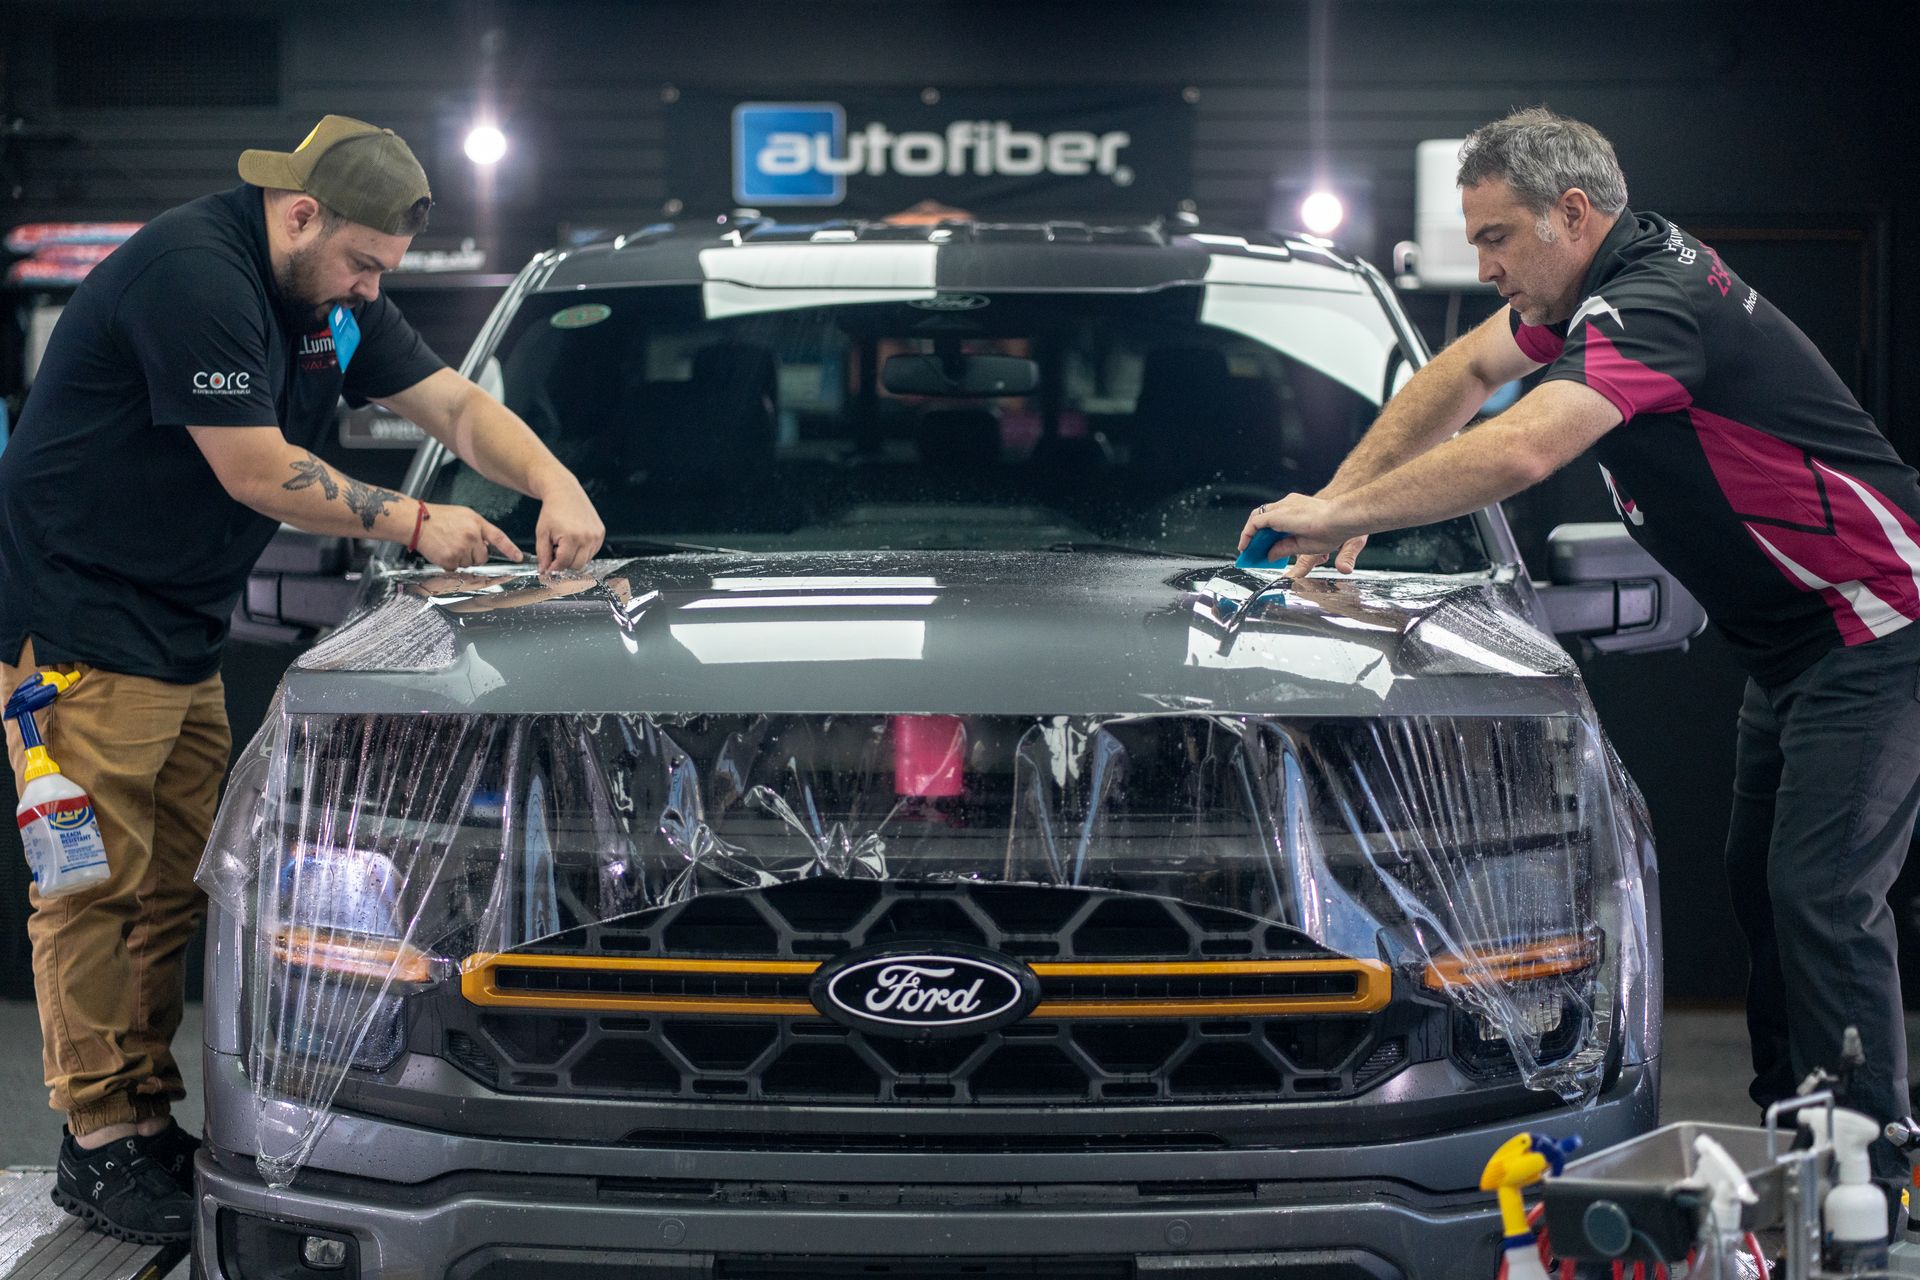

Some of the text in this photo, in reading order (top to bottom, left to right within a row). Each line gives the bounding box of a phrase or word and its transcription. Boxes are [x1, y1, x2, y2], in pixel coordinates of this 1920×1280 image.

[757, 120, 1131, 177] autofiber
[193, 371, 250, 390] core
[865, 964, 985, 1013] Ford
